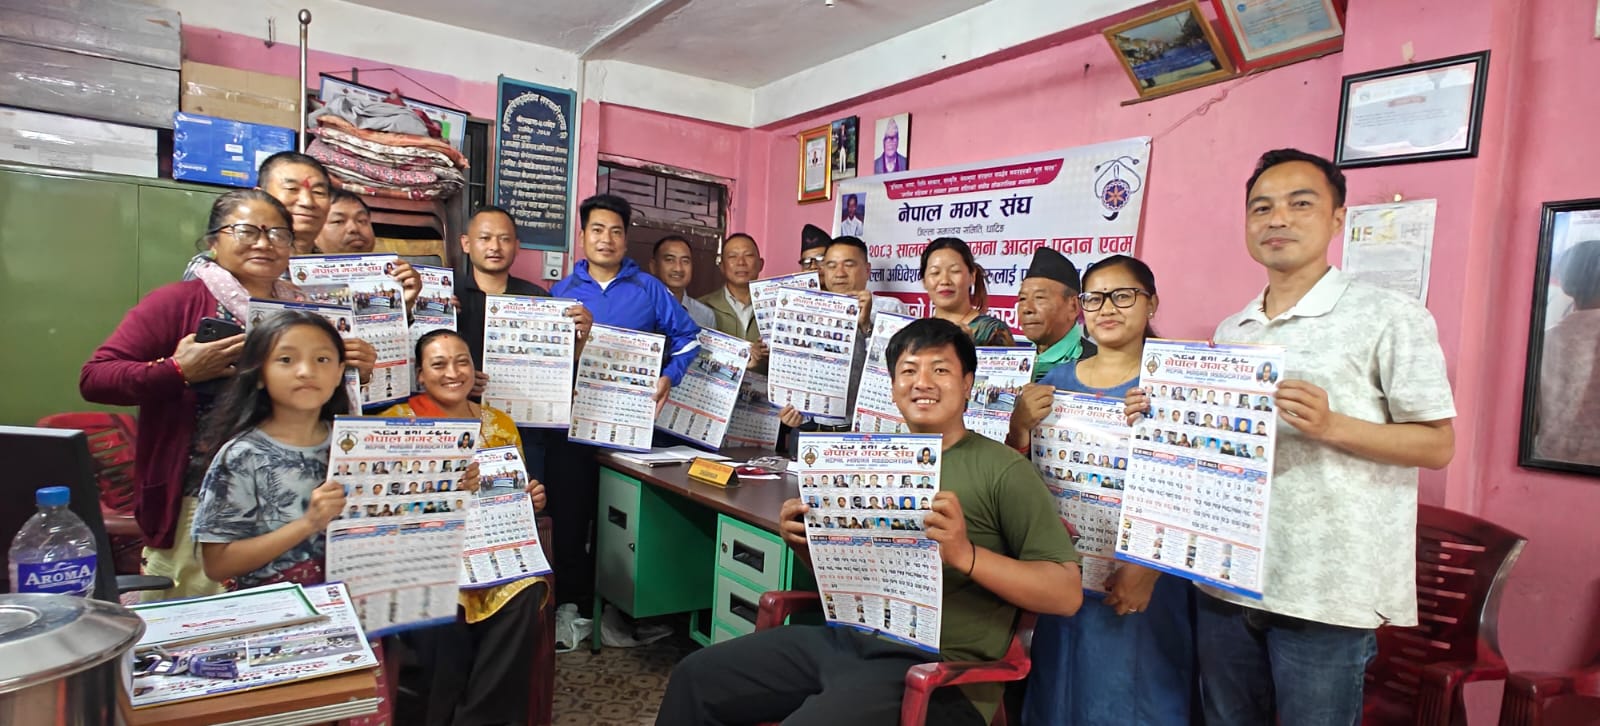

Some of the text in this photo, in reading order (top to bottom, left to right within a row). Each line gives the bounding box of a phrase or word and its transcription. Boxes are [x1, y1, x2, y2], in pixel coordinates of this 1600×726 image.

[899, 193, 1033, 222] नेपाल मगर संघ
[869, 244, 892, 259] २०८३
[1165, 357, 1197, 369] नेपाल
[1199, 361, 1229, 371] मगर
[364, 433, 401, 443] नेपाल
[404, 435, 432, 443] मगर
[823, 448, 859, 457] नेपाल
[895, 449, 915, 458] संघ
[25, 564, 91, 585] AROMA
